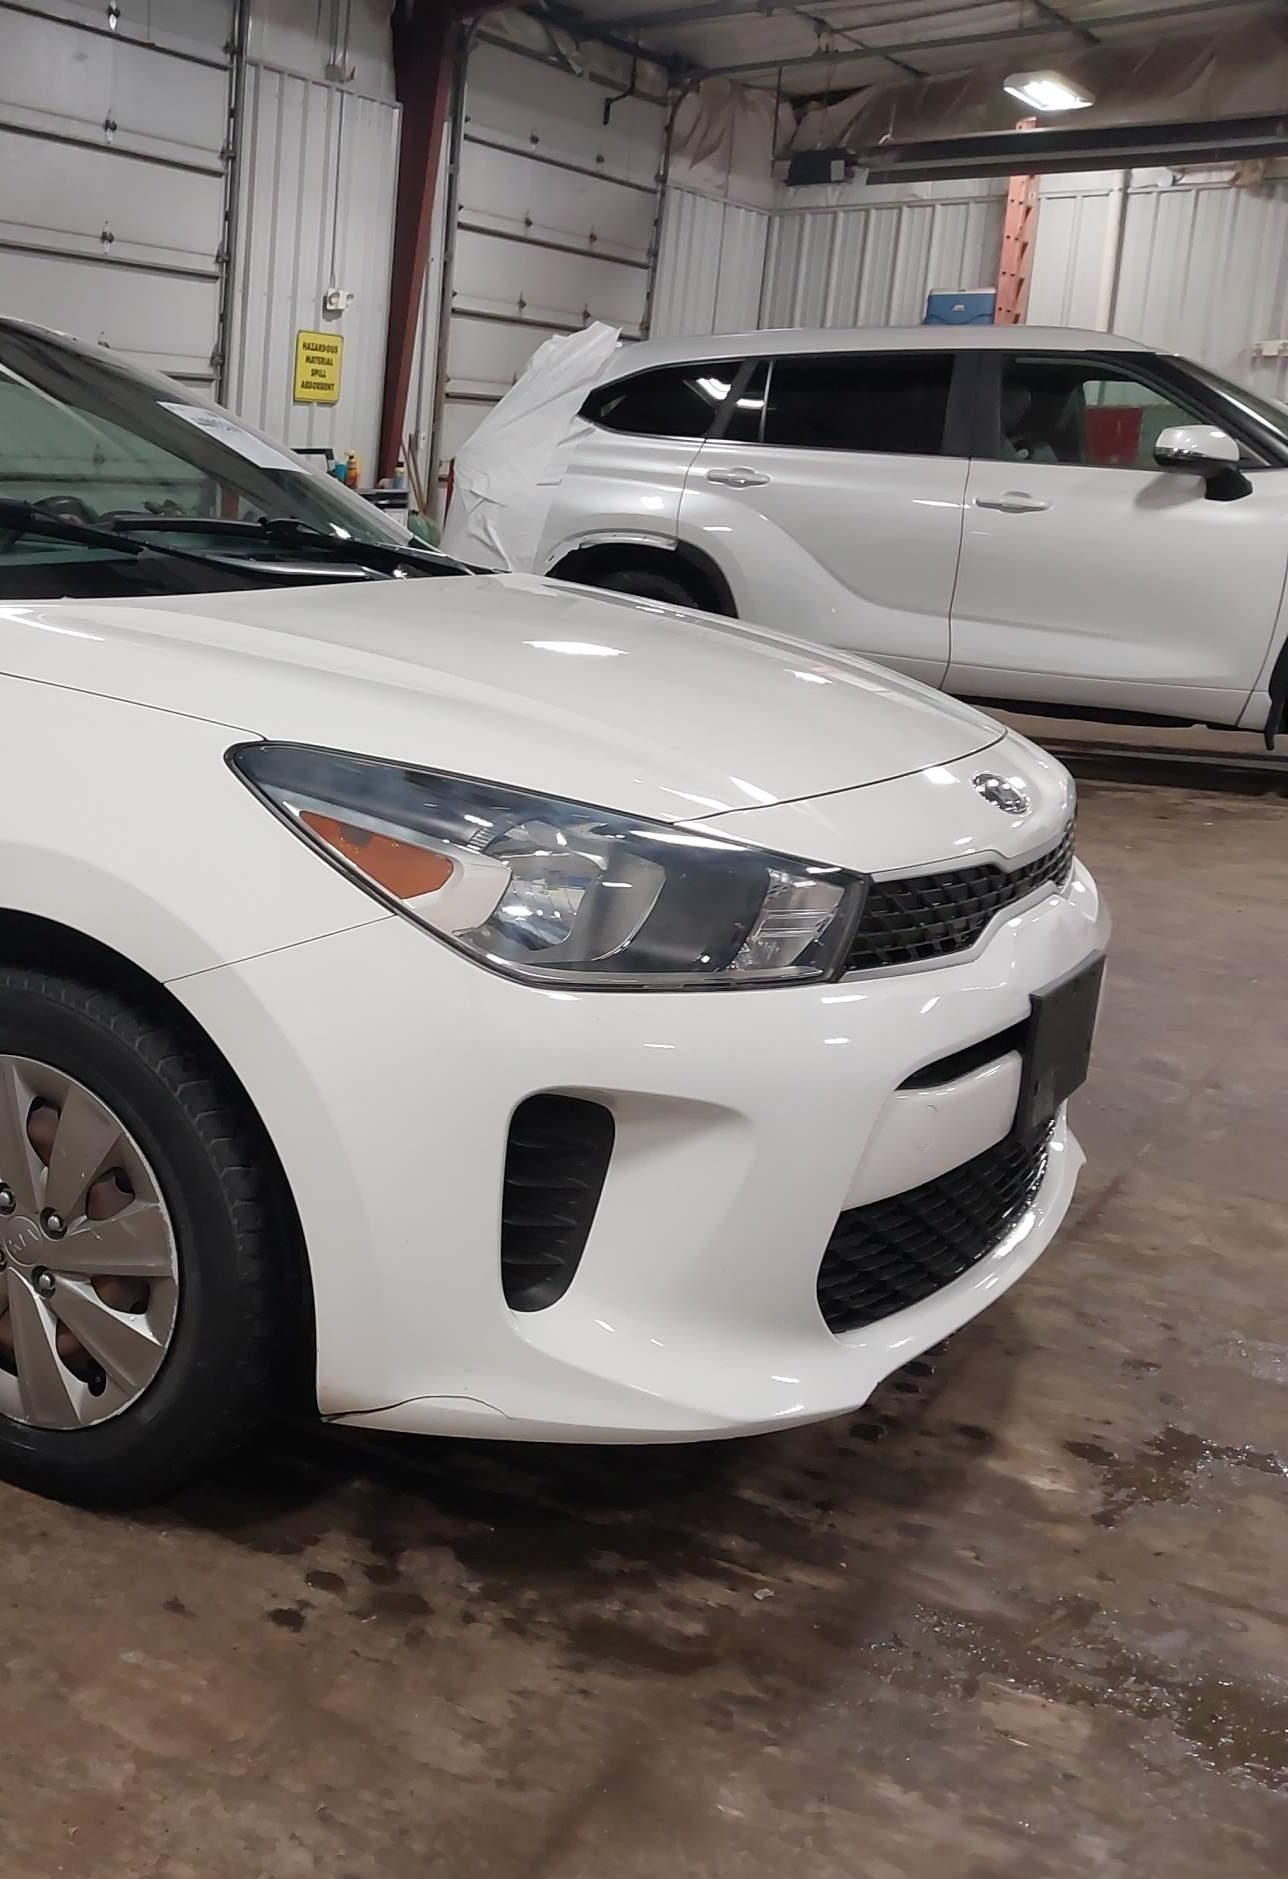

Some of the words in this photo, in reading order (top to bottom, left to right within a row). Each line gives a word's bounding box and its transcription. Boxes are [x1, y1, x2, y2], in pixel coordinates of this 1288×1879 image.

[302, 341, 339, 354] HAZARDOUS
[305, 355, 334, 366] MATERIAL
[310, 368, 327, 378] SPILL
[300, 380, 335, 391] ABSORBENT
